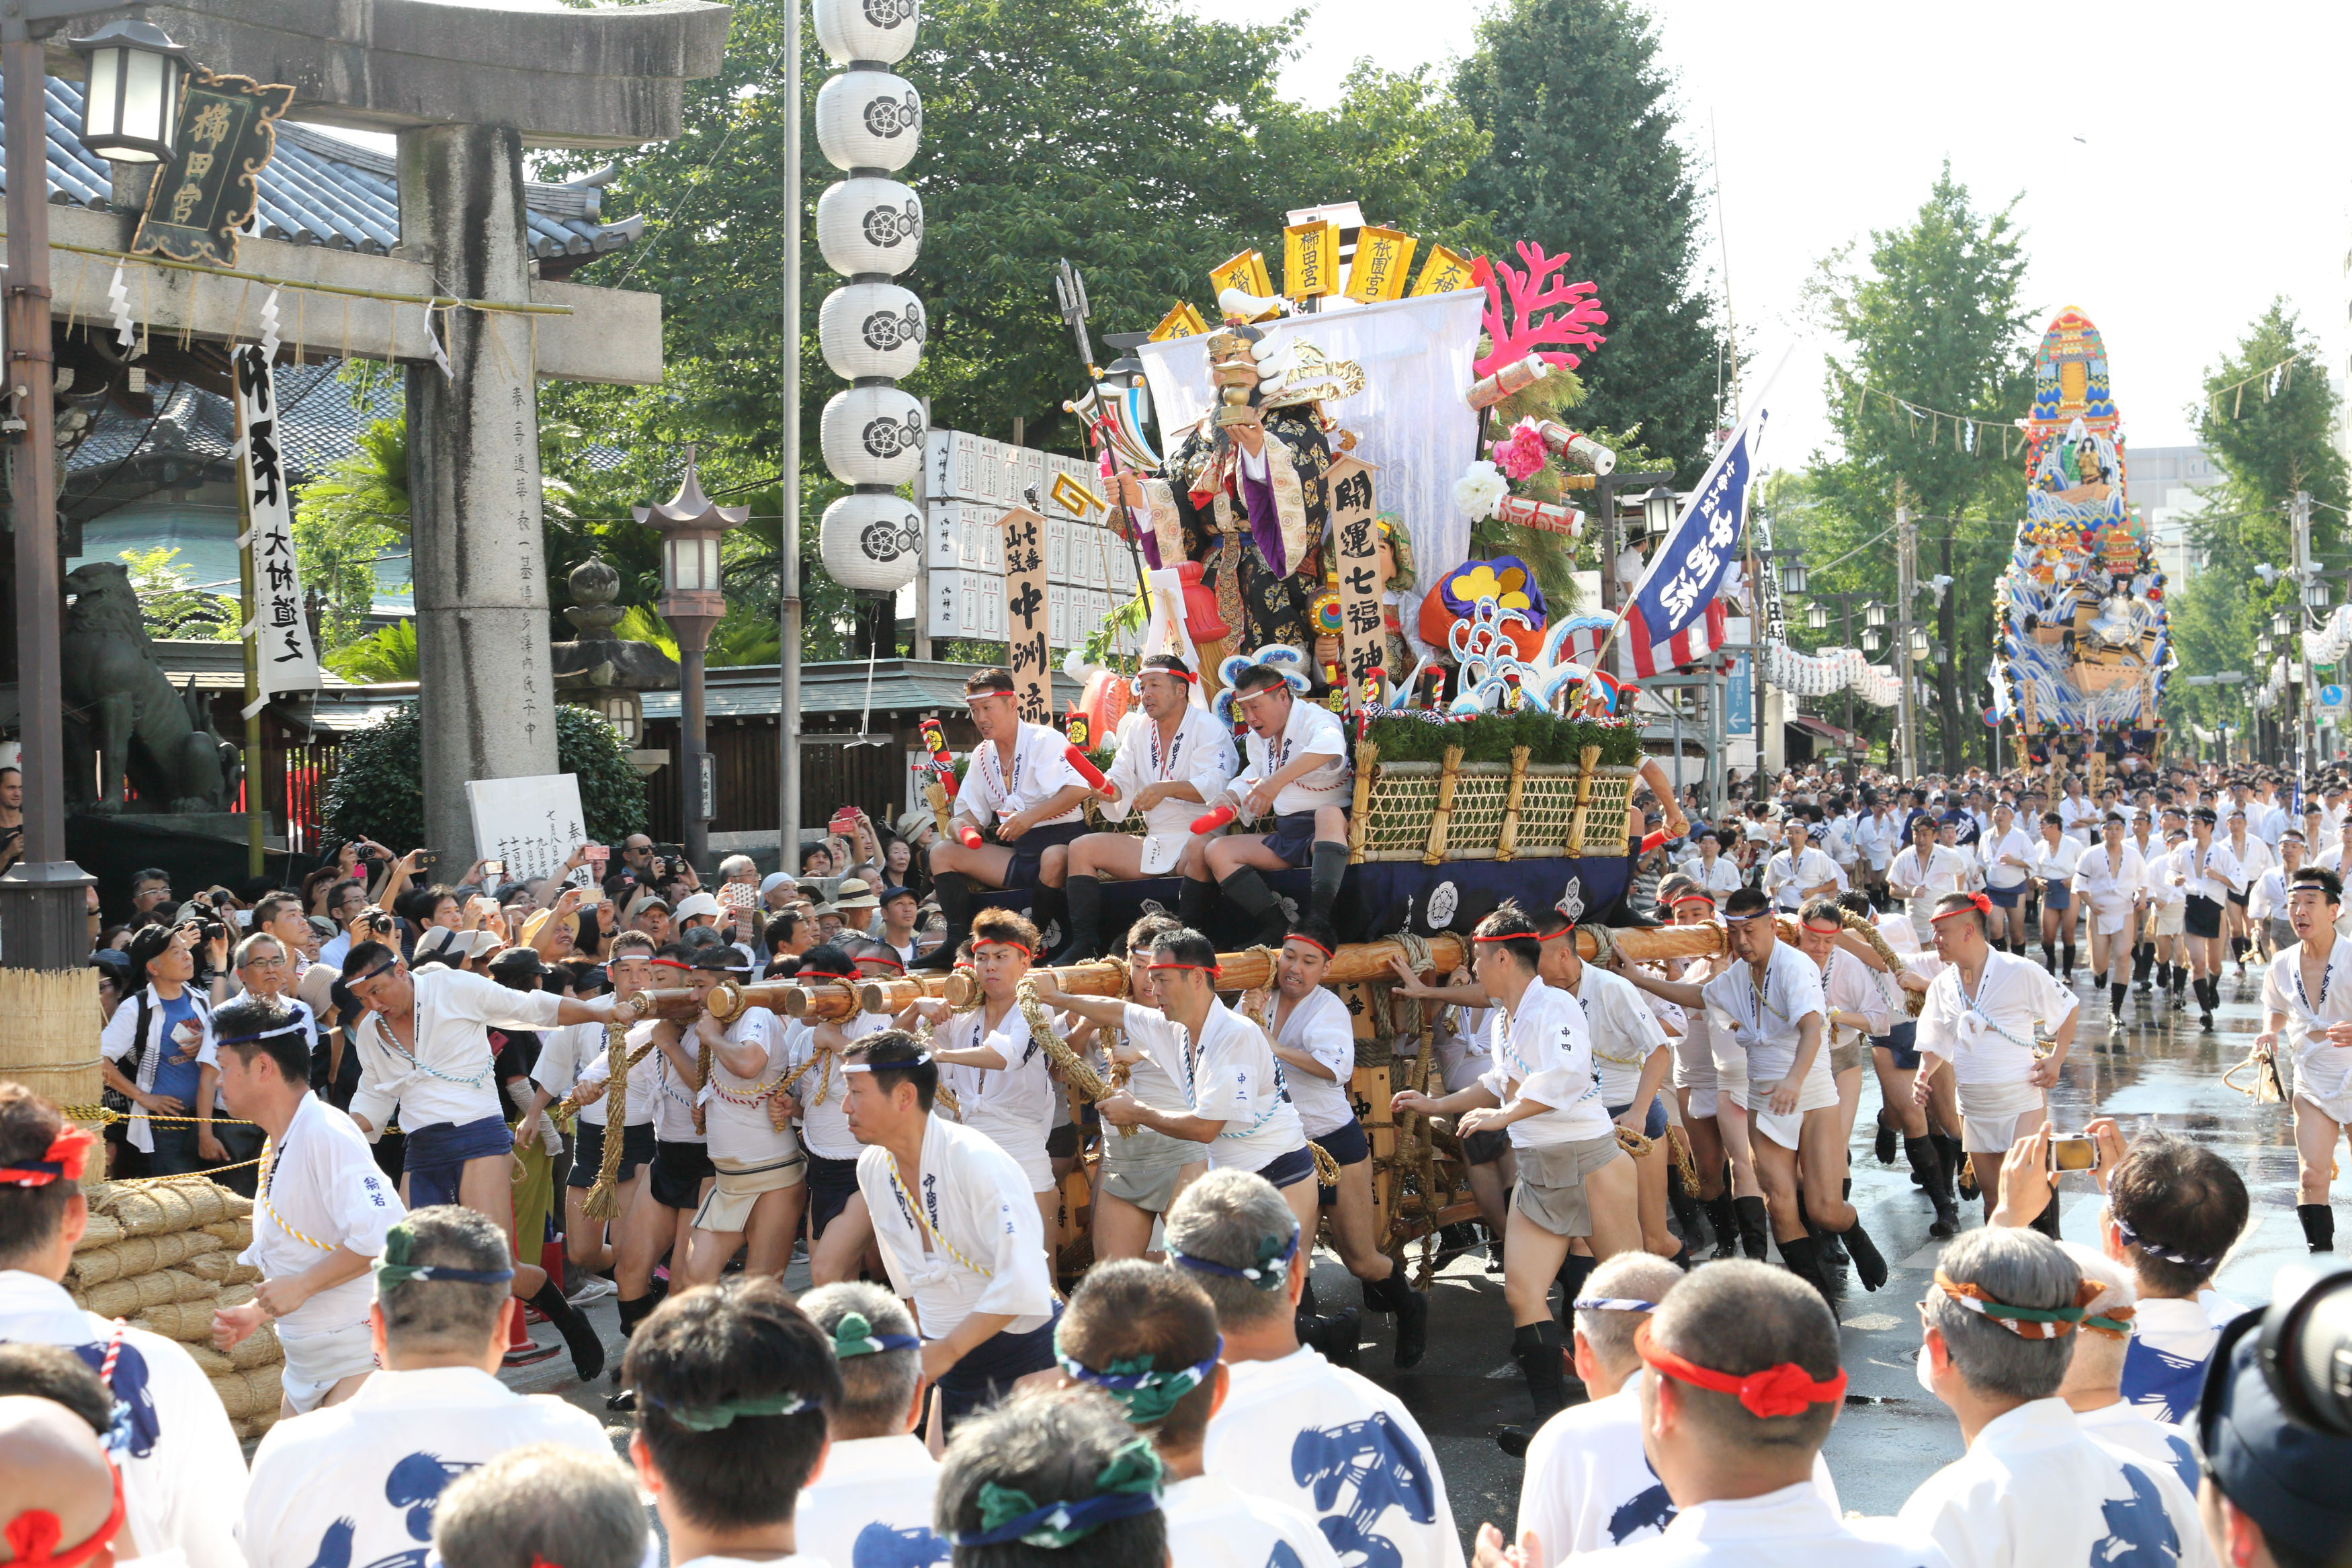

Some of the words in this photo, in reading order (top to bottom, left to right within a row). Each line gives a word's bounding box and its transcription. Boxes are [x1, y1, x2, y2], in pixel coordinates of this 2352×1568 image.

[173, 101, 233, 223] 櫛田宮
[1299, 230, 1319, 288] 櫛田宮
[1366, 237, 1392, 296] 祇園宮
[1005, 525, 1027, 576] 山笠
[1022, 521, 1043, 571] 七番
[1660, 509, 1734, 631] 中洲流
[1335, 470, 1383, 687] 開運七福神
[1009, 582, 1051, 725] 中洲流
[1561, 1027, 1571, 1051] 中四
[1236, 1072, 1247, 1100] 中二
[364, 1176, 385, 1207] 翁若
